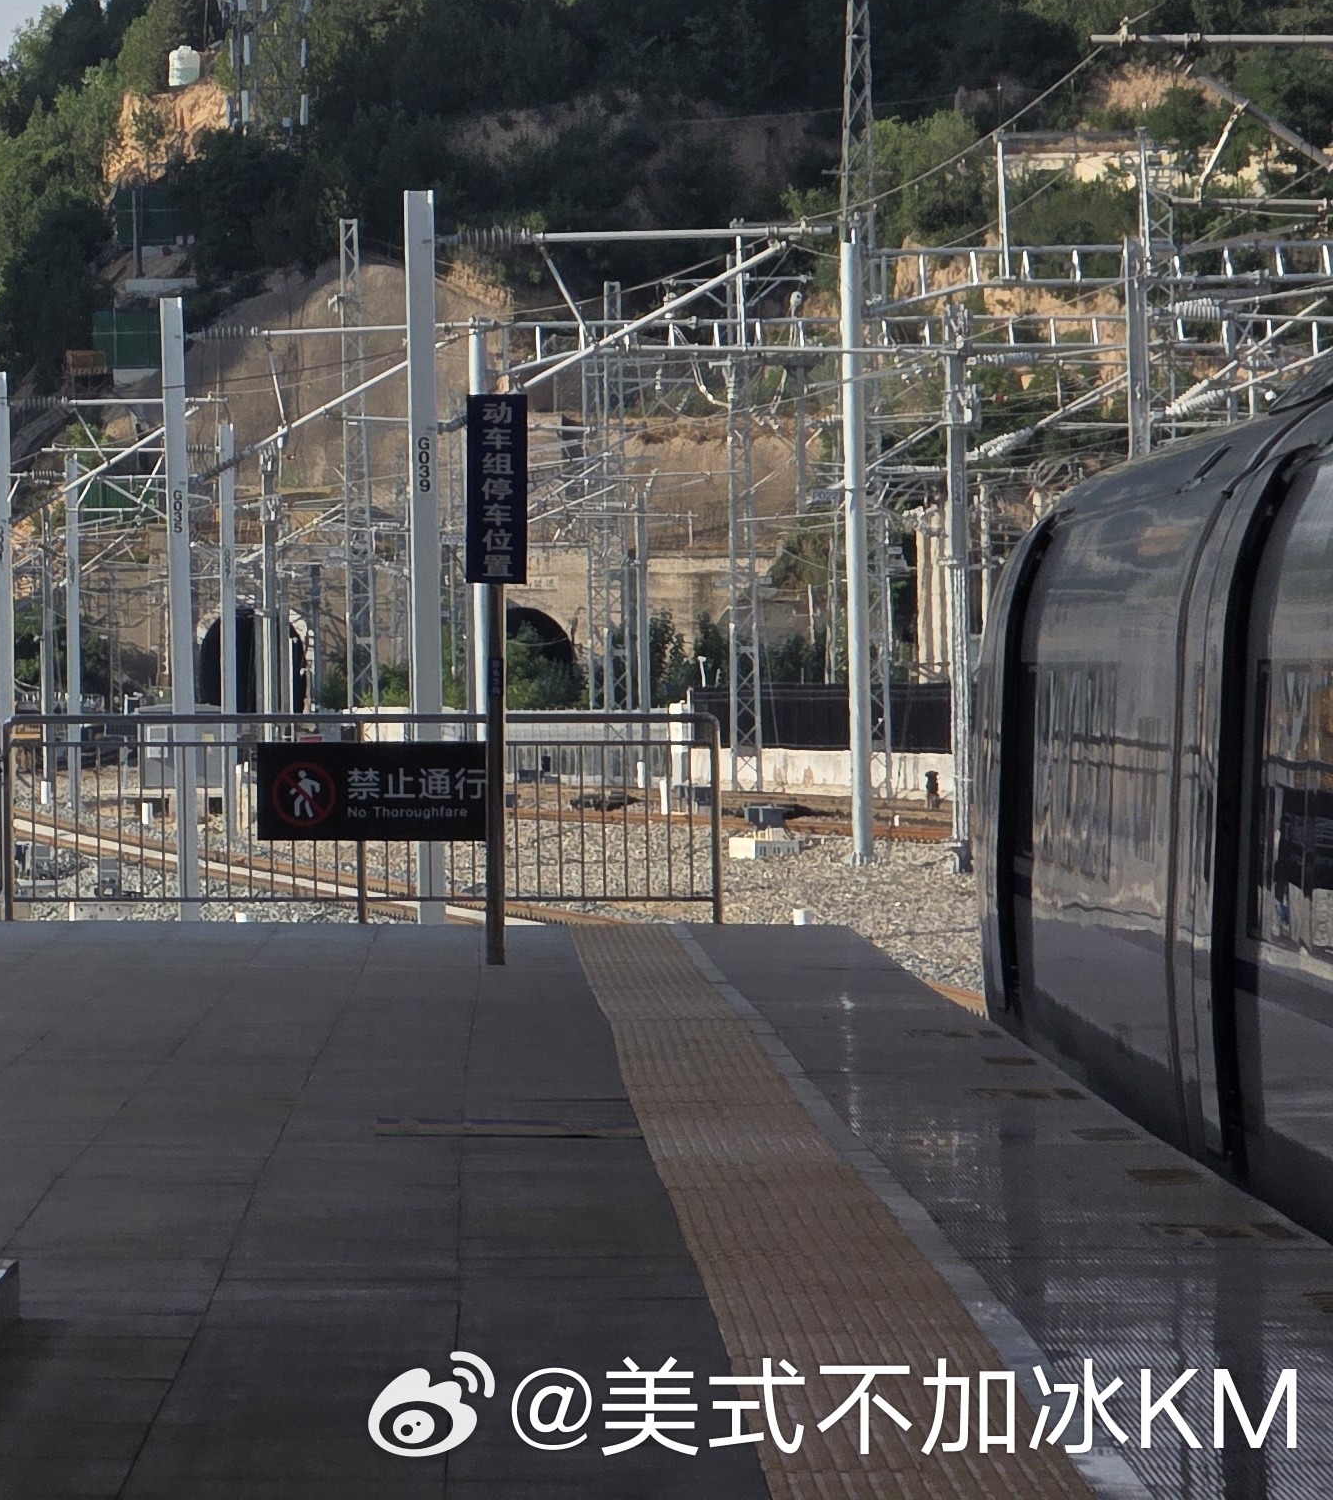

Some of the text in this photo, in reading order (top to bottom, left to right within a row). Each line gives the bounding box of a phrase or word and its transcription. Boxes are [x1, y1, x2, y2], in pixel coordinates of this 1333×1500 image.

[418, 436, 430, 492] G039
[173, 489, 182, 533] G035
[481, 402, 514, 578] 动车组停车位置
[347, 767, 488, 800] 禁止通行
[347, 805, 468, 819] No Thoroughfare
